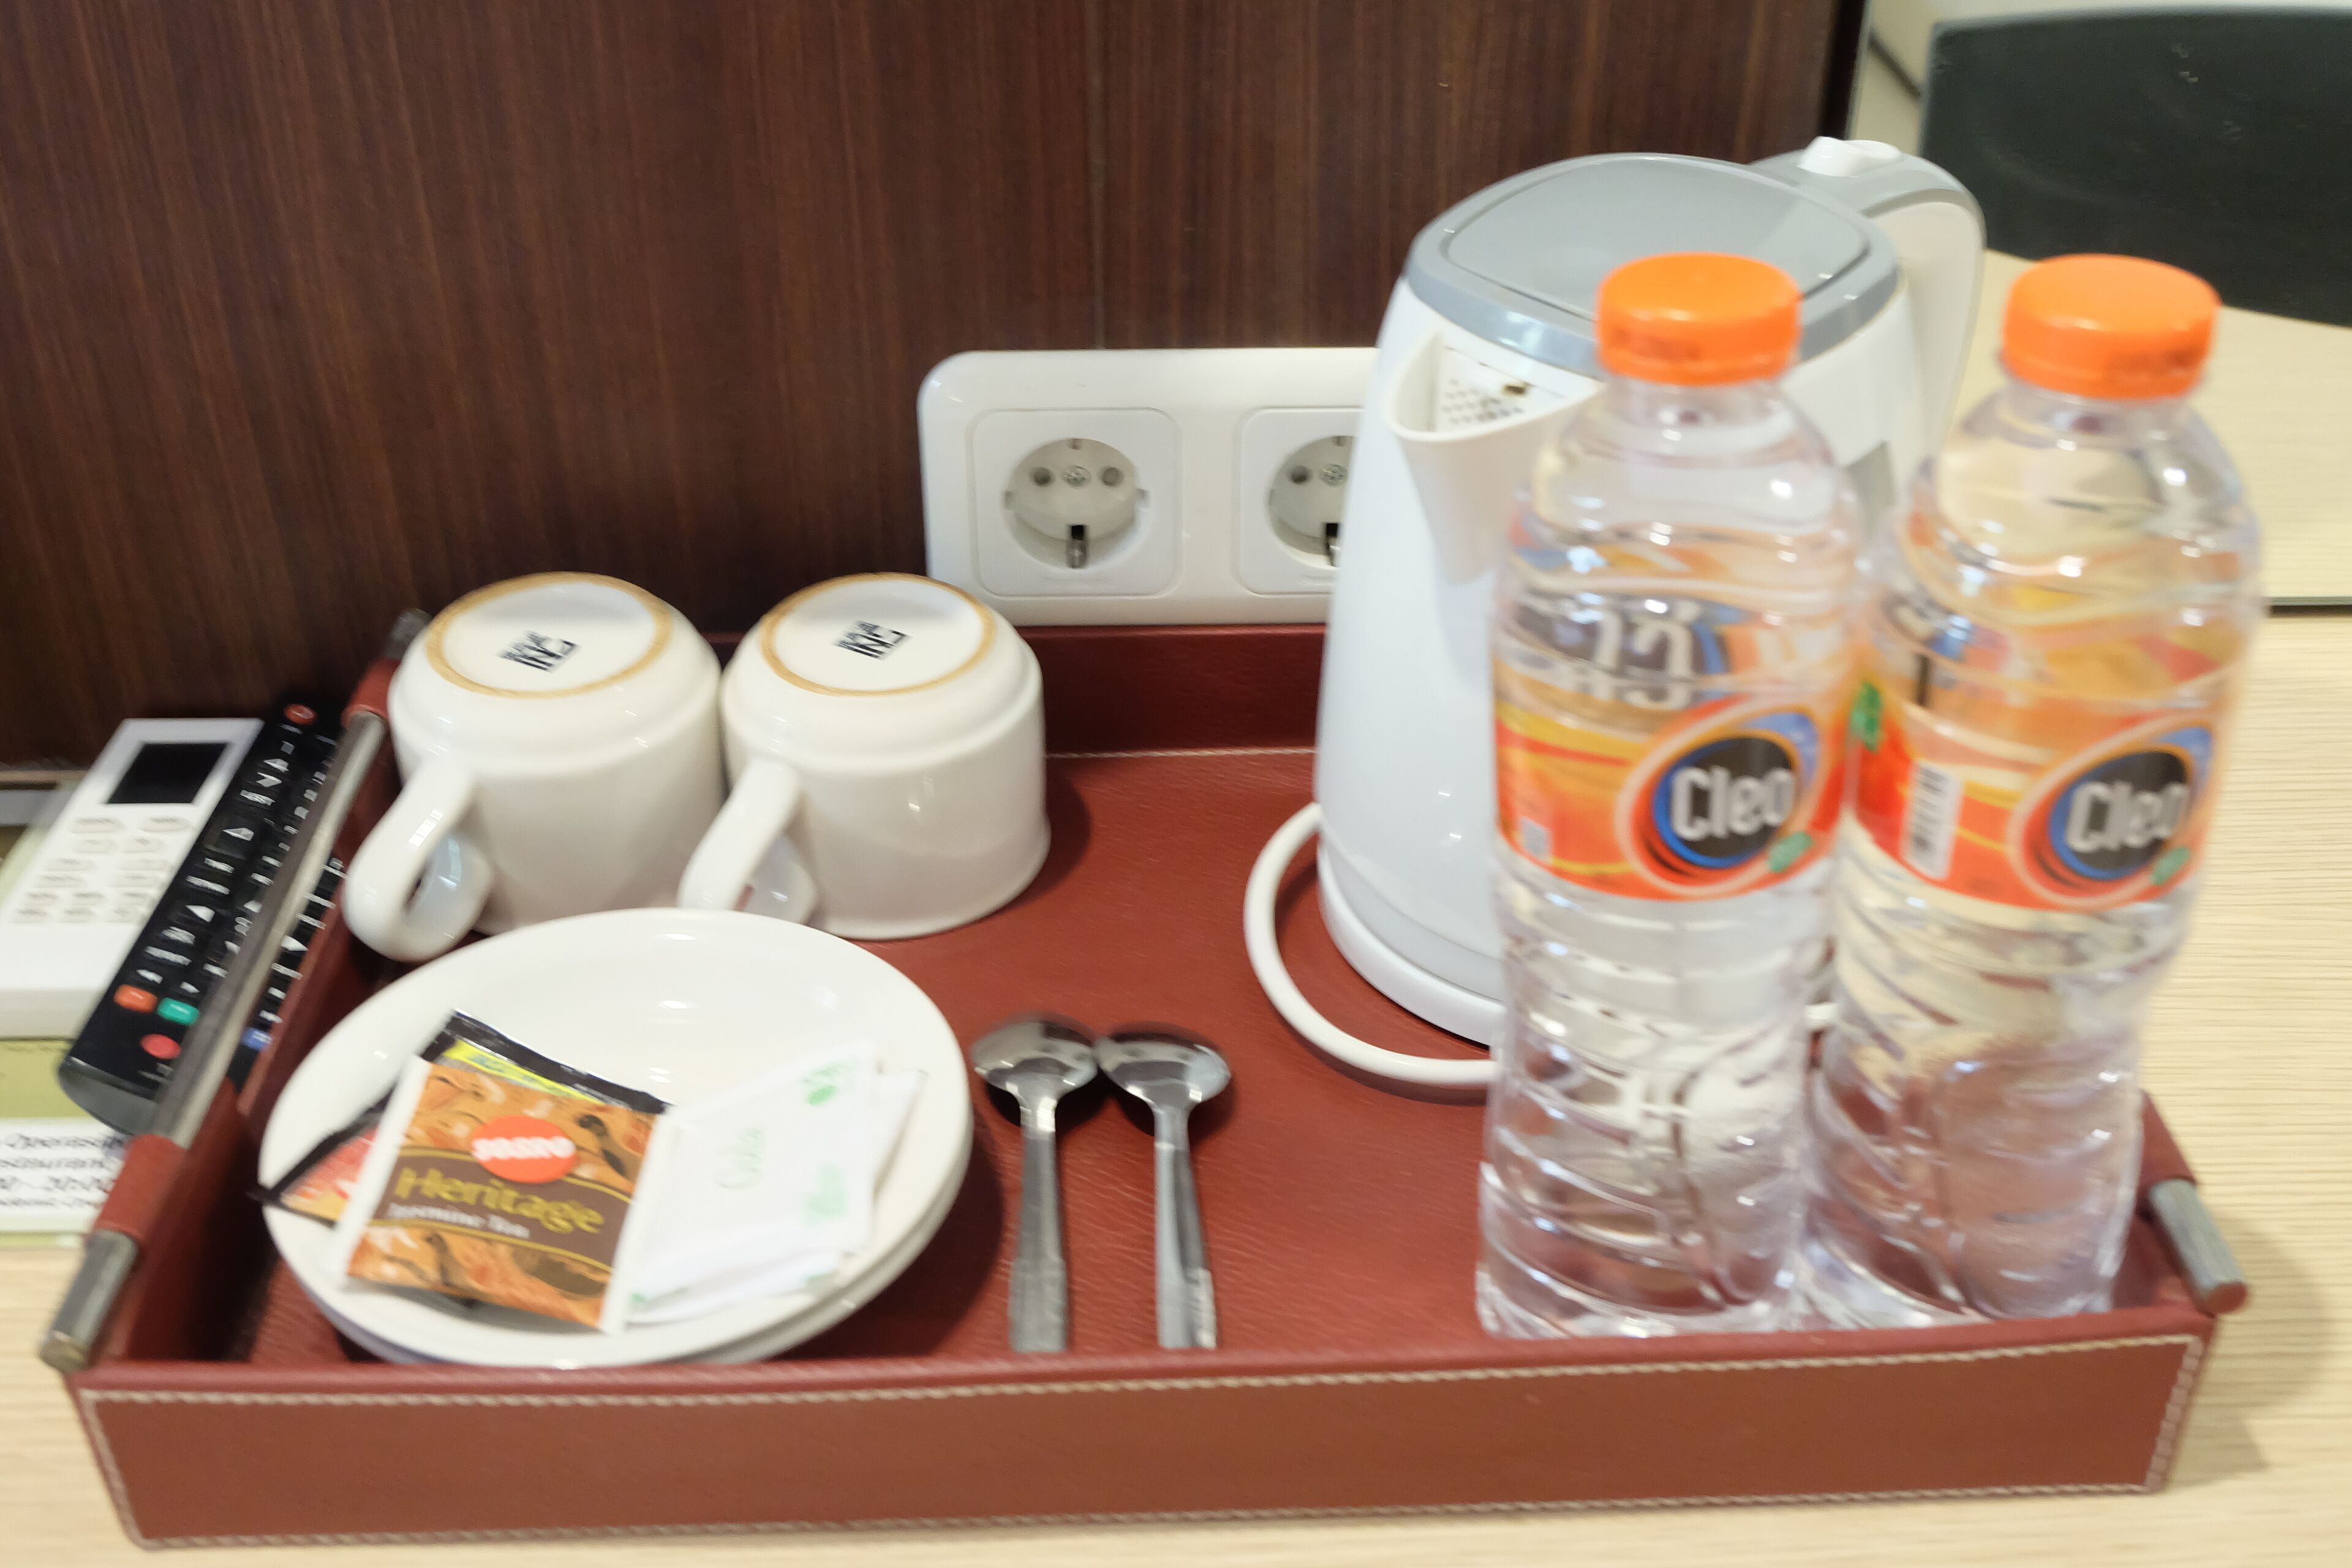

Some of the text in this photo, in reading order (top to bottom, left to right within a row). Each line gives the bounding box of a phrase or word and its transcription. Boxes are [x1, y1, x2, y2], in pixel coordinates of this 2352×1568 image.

[1670, 764, 1796, 842] Cleo
[2066, 780, 2192, 853] Cleo
[394, 1166, 605, 1234] Heritage
